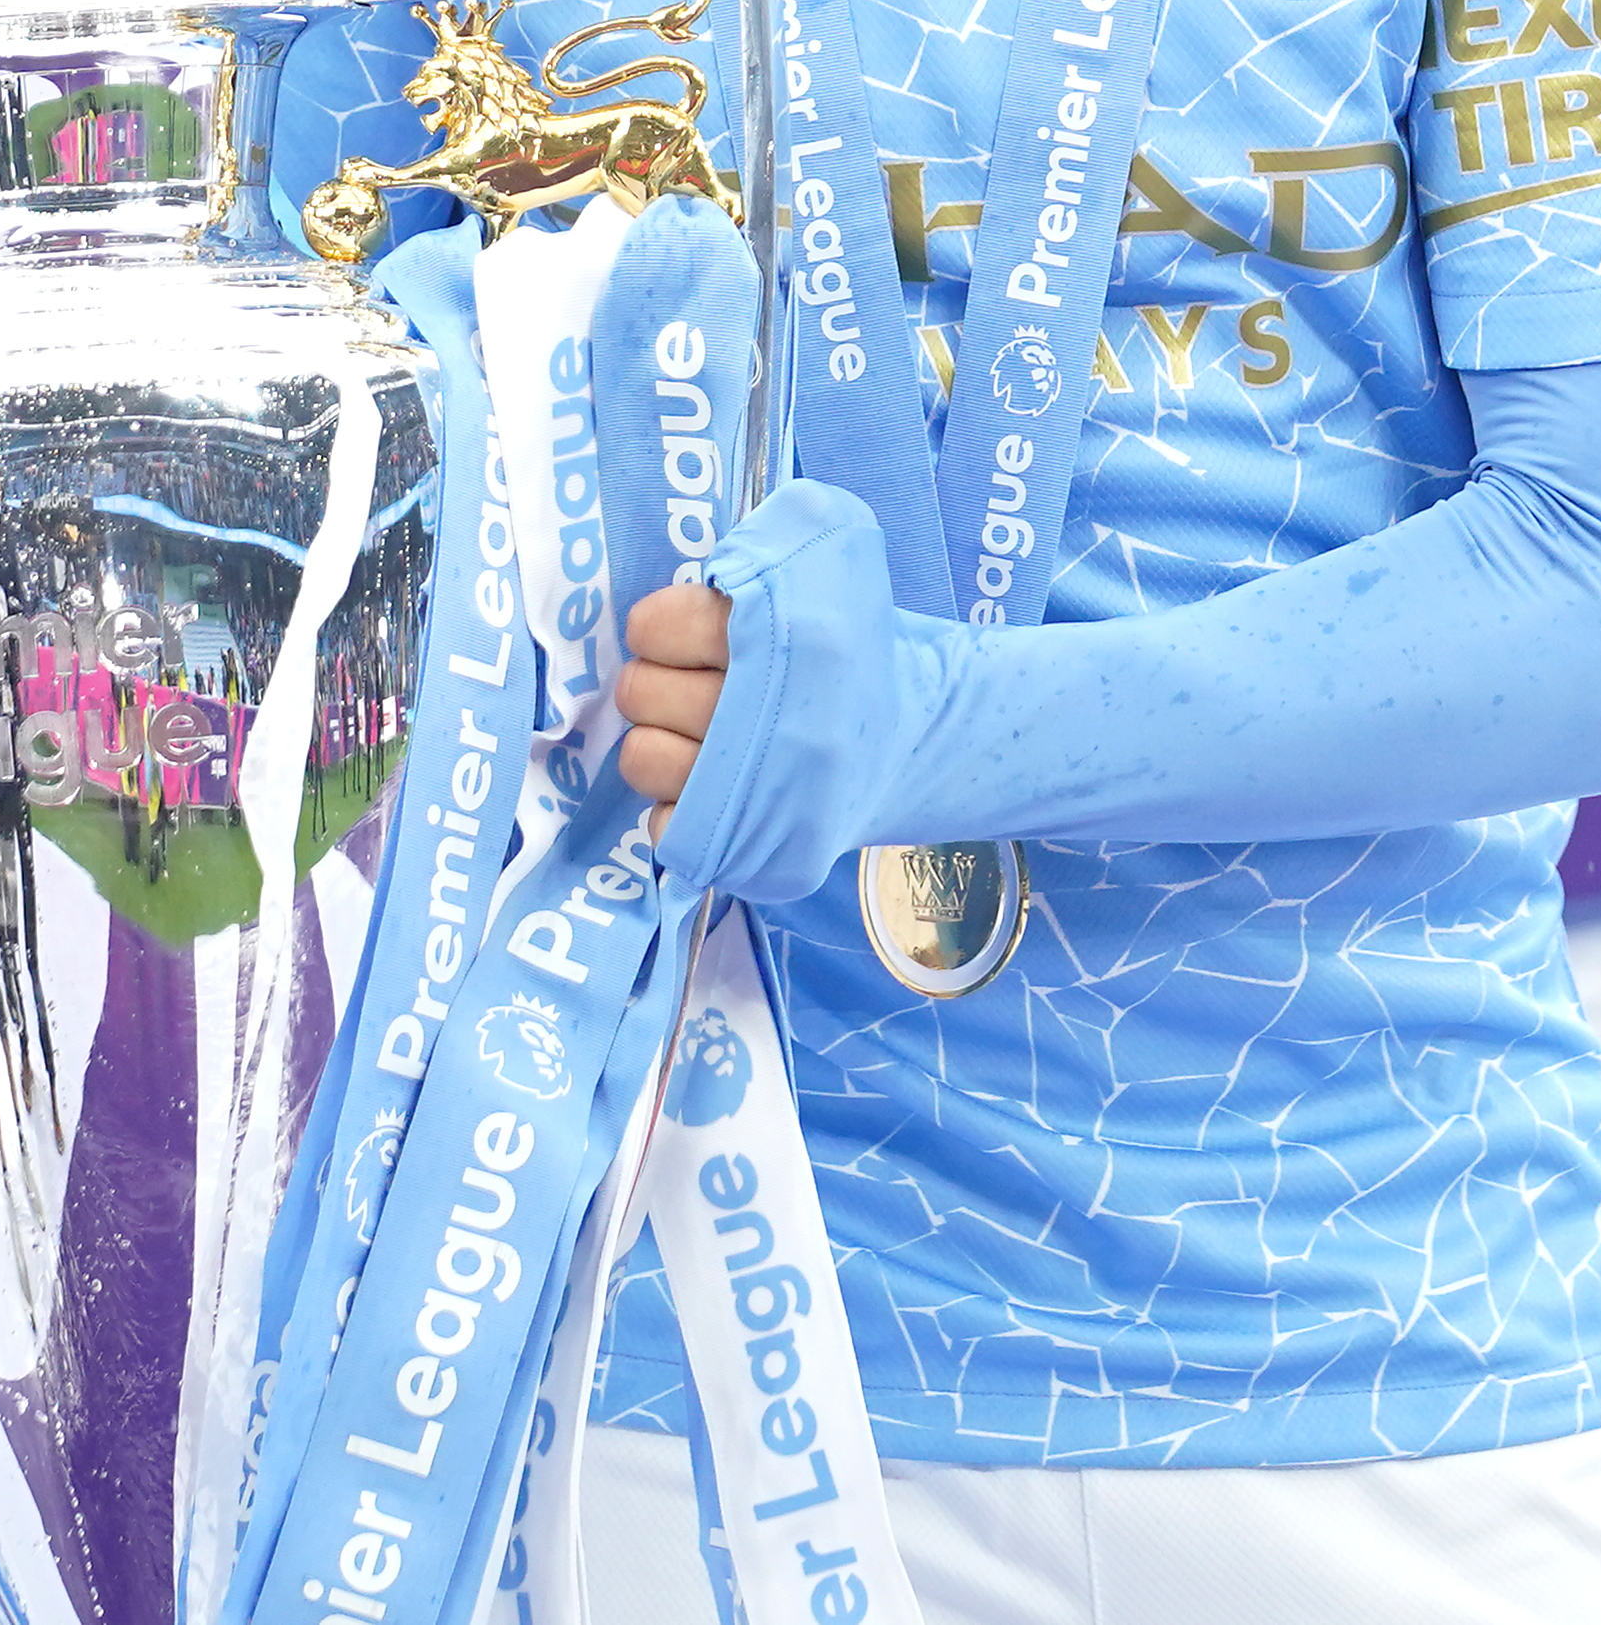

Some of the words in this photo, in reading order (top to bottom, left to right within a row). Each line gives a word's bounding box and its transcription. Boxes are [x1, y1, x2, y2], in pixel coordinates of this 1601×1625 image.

[790, 135, 867, 381] League
[1006, 65, 1102, 309] Premier
[549, 336, 605, 698] League
[376, 707, 499, 1081] Premier
[344, 1111, 537, 1479] League
[700, 1151, 840, 1522] League
